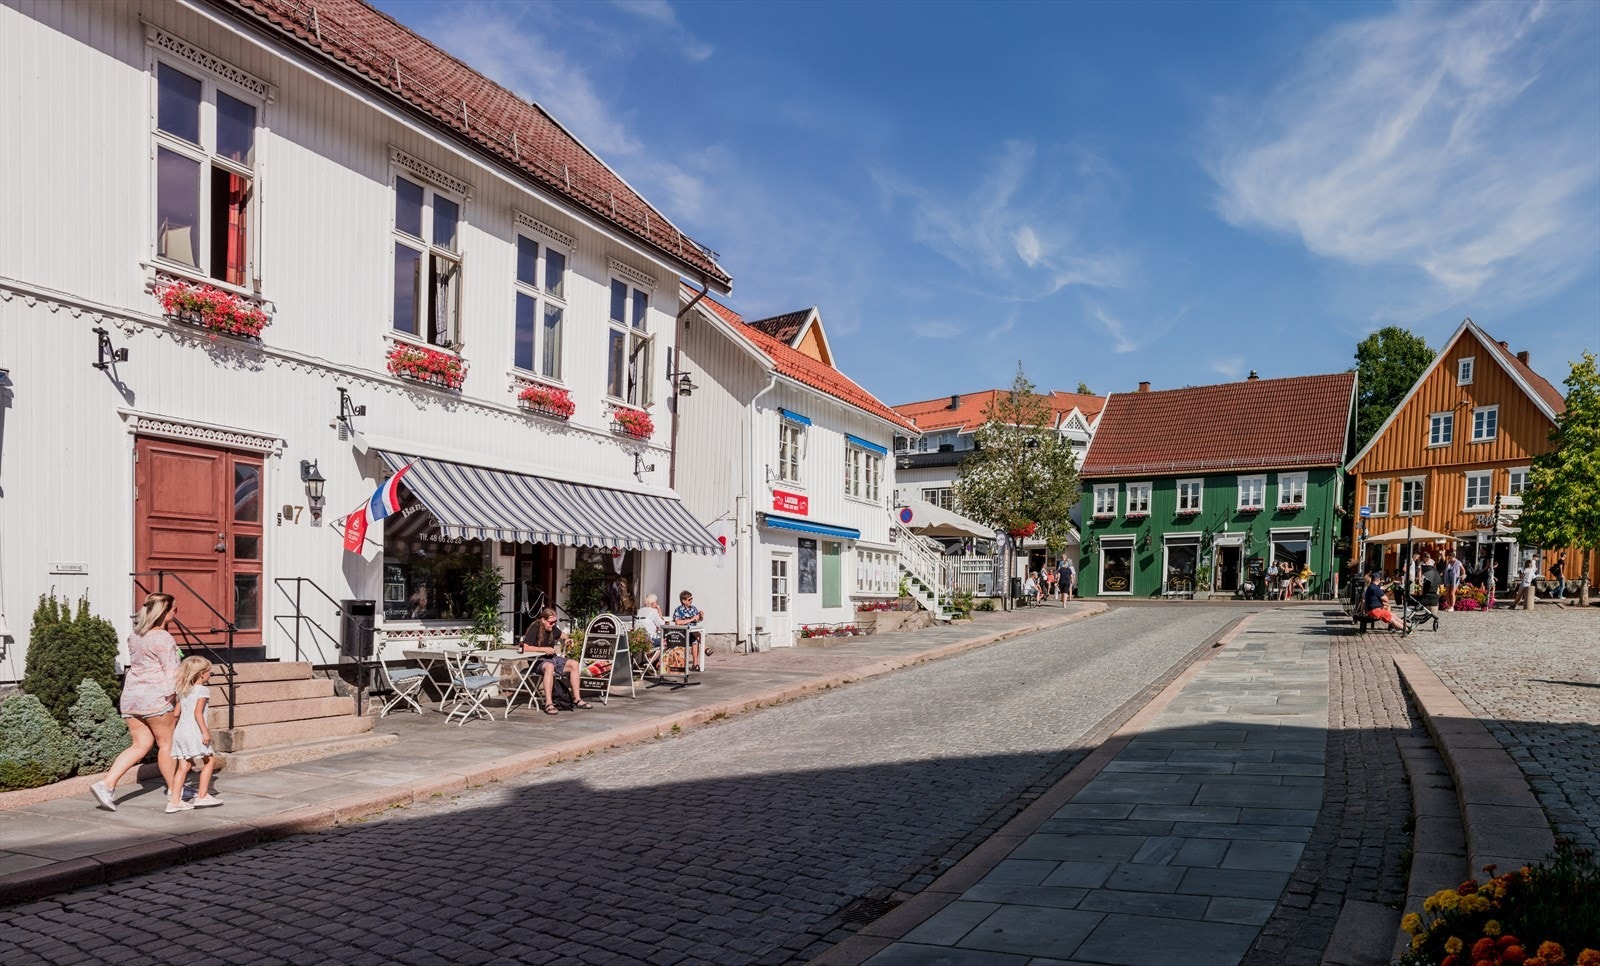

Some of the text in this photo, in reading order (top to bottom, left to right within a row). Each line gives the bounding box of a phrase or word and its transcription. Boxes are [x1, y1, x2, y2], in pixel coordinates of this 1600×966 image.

[294, 505, 304, 525] 7
[401, 503, 428, 518] Bang
[589, 647, 611, 655] SUSHI
